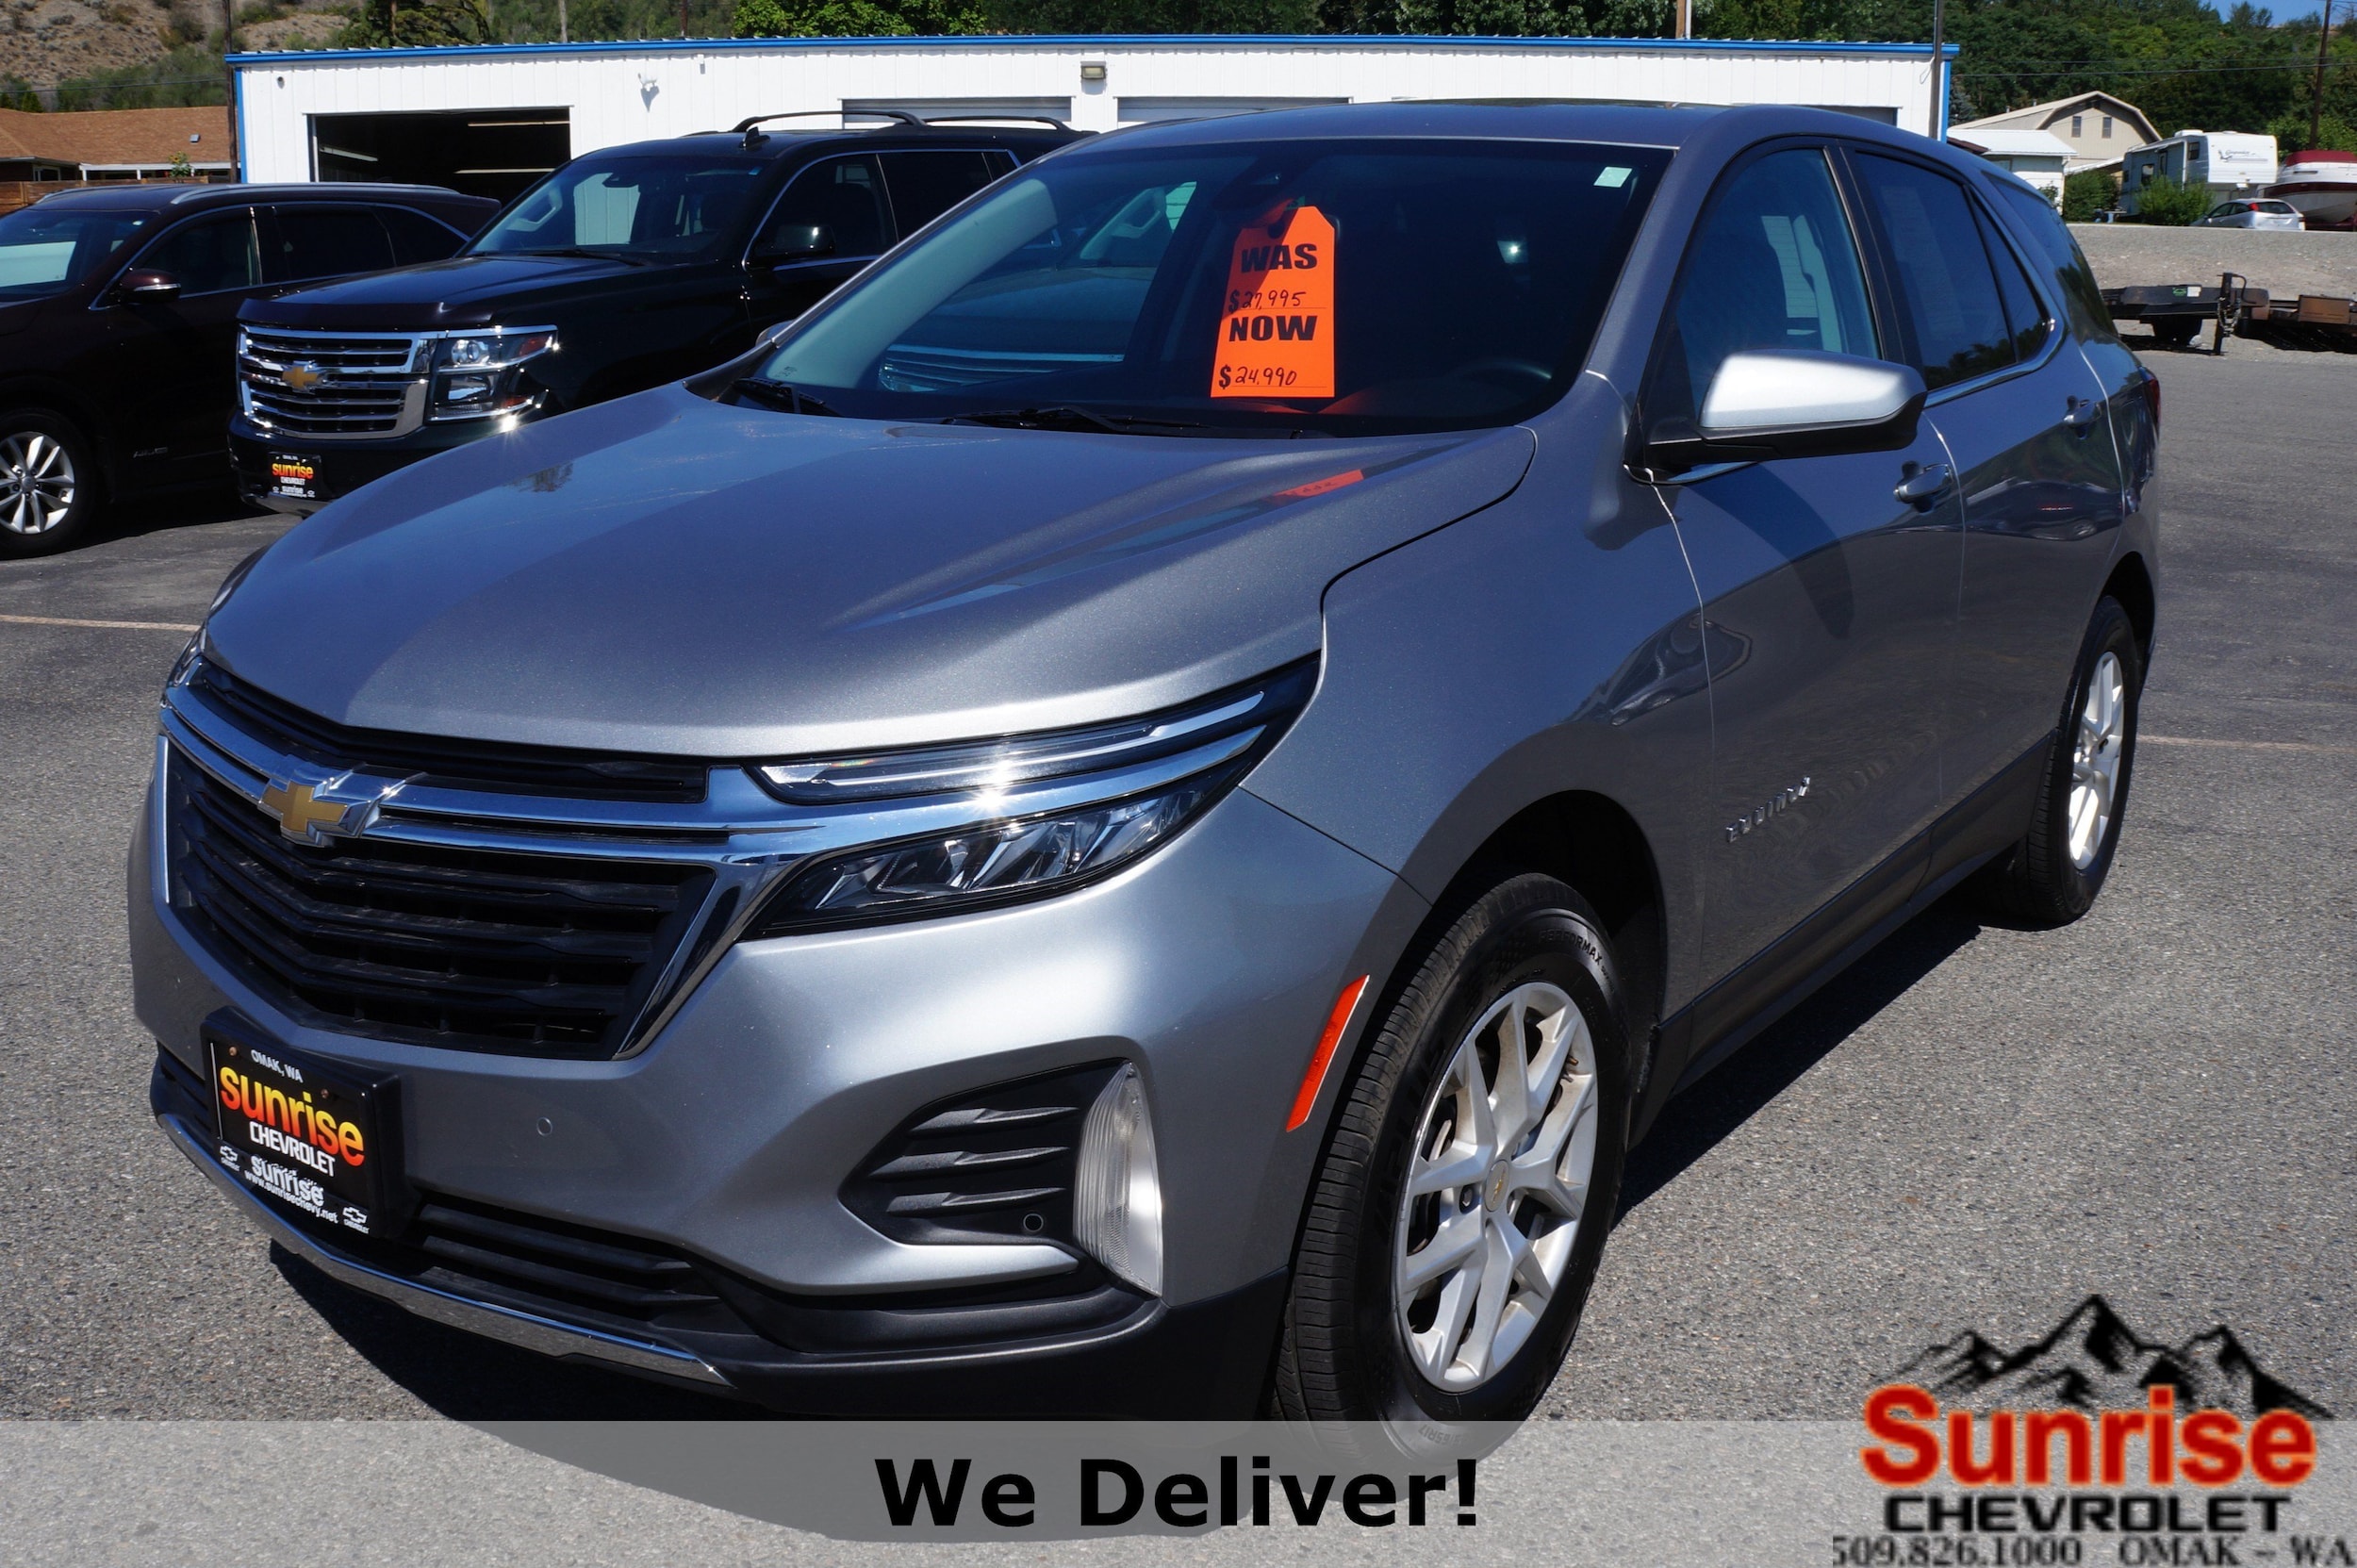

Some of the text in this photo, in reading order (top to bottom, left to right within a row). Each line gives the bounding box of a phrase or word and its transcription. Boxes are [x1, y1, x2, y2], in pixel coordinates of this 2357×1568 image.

[1241, 243, 1317, 272] WAS
[1228, 315, 1318, 342] NOW
[272, 462, 314, 479] sunrise
[250, 1049, 304, 1083] OMAK, WA
[220, 1066, 365, 1166] sunrise
[249, 1120, 336, 1177] CHEVROLET
[251, 1154, 324, 1206] sunrise
